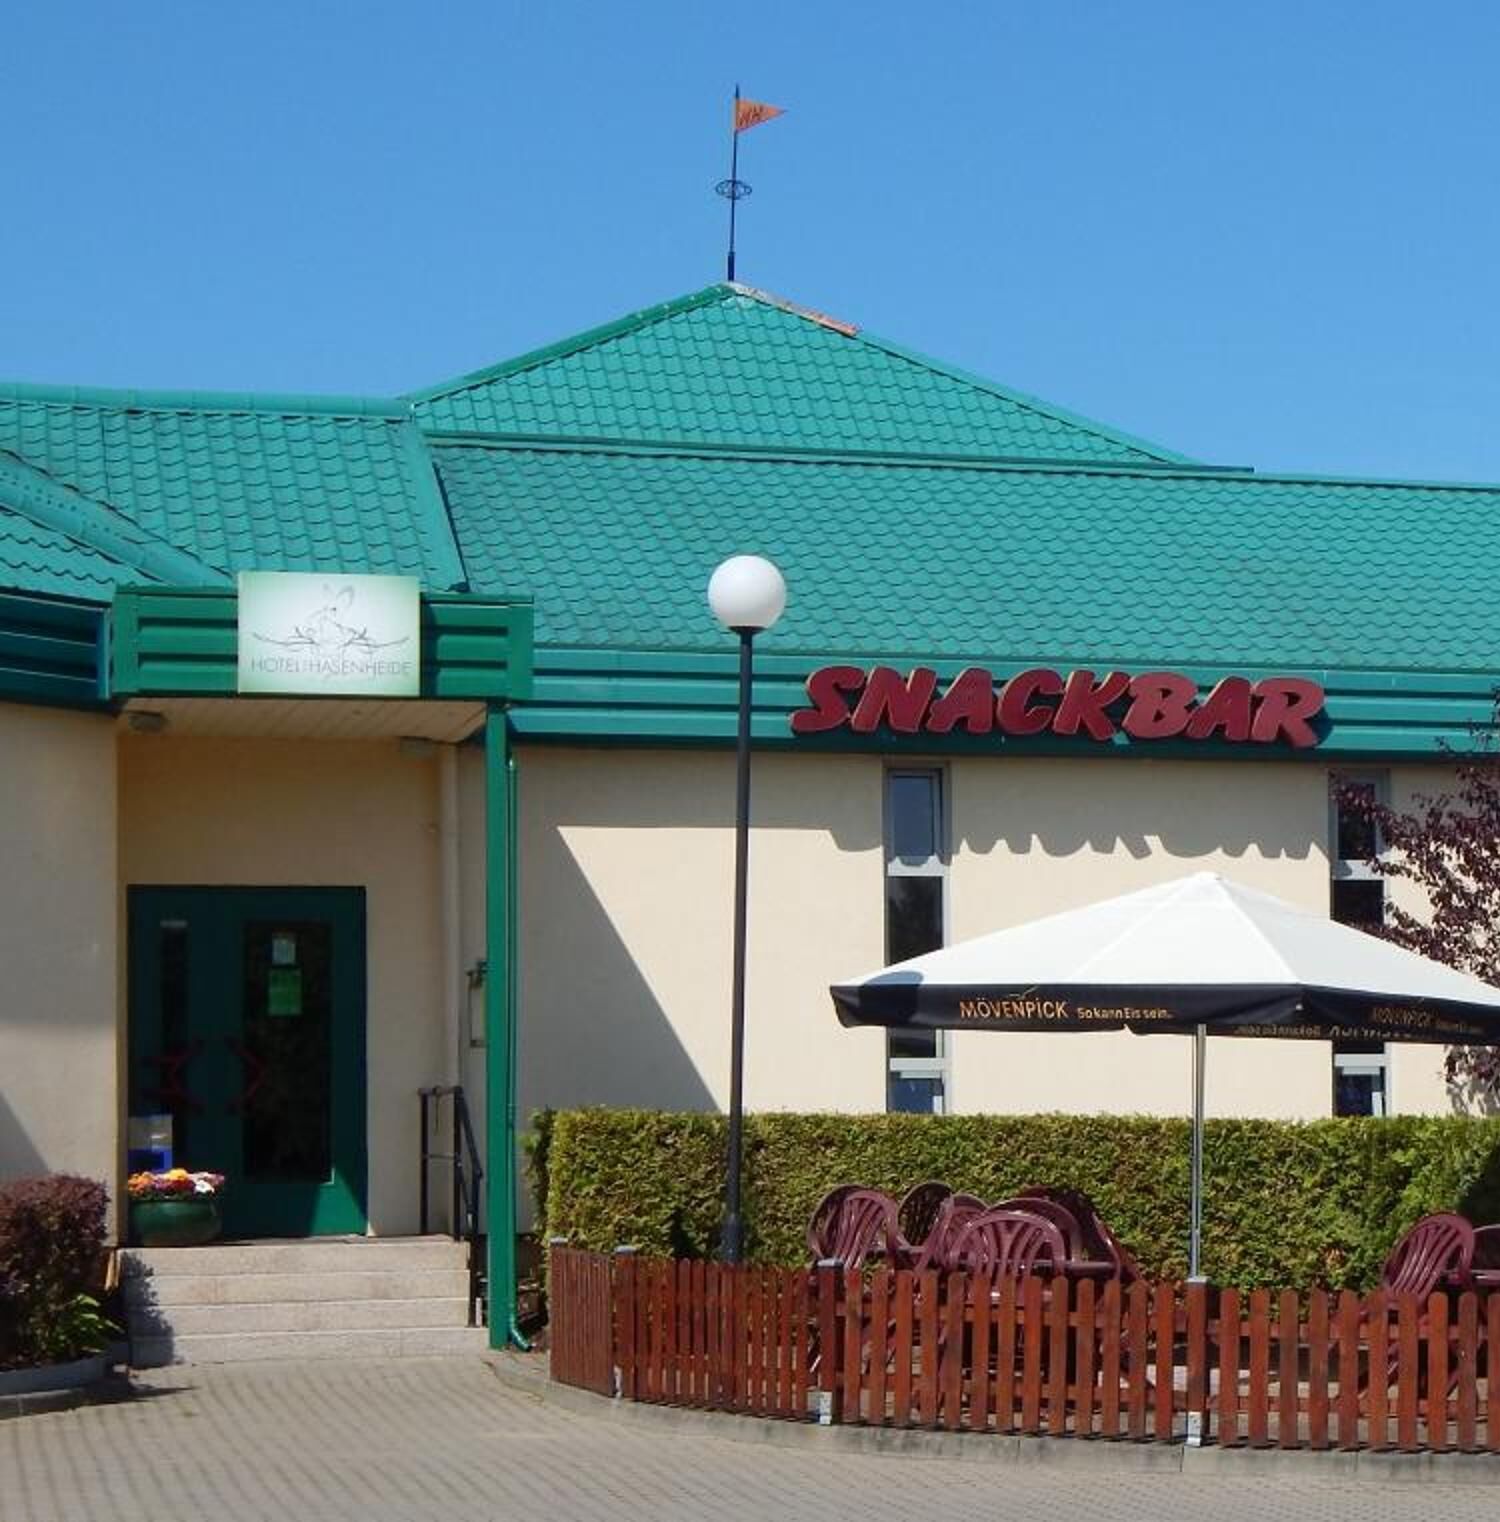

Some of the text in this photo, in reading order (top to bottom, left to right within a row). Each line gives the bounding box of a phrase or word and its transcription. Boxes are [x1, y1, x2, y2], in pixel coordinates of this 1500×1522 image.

[250, 655, 413, 676] HOTEL HASENHEIDE
[791, 664, 1326, 748] SNACKBAR
[960, 997, 1069, 1019] MÖVENPICK
